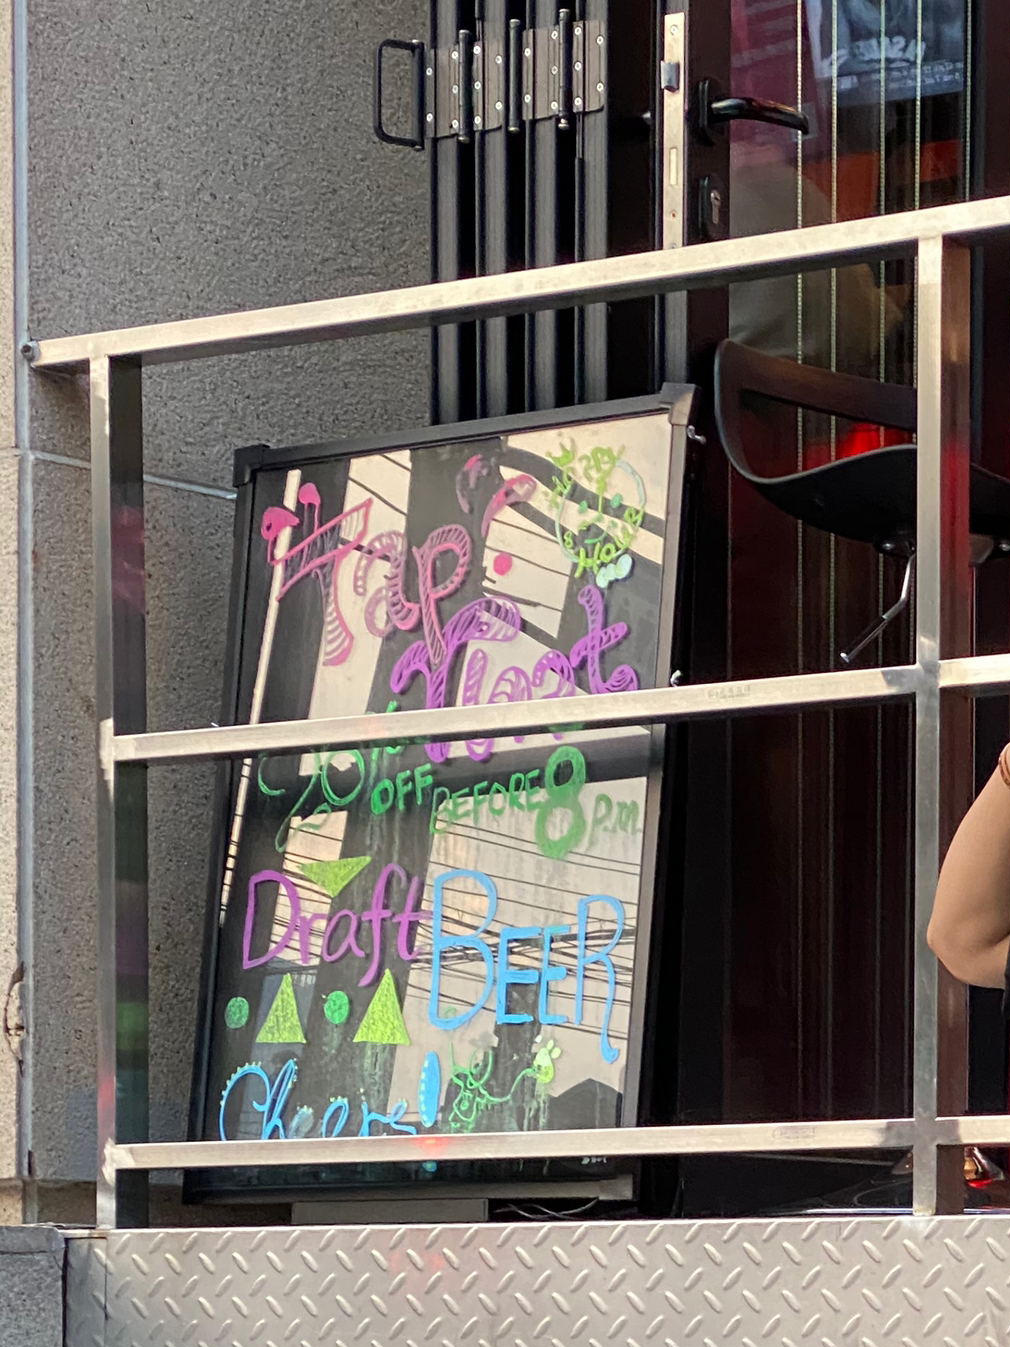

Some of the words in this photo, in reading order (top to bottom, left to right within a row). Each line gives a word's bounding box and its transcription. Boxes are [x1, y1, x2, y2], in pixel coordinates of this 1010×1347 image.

[371, 762, 434, 815] OFF
[429, 768, 542, 835] BEFORE
[534, 746, 587, 860] 8
[242, 863, 434, 988] Draft
[427, 868, 626, 1065] BEER
